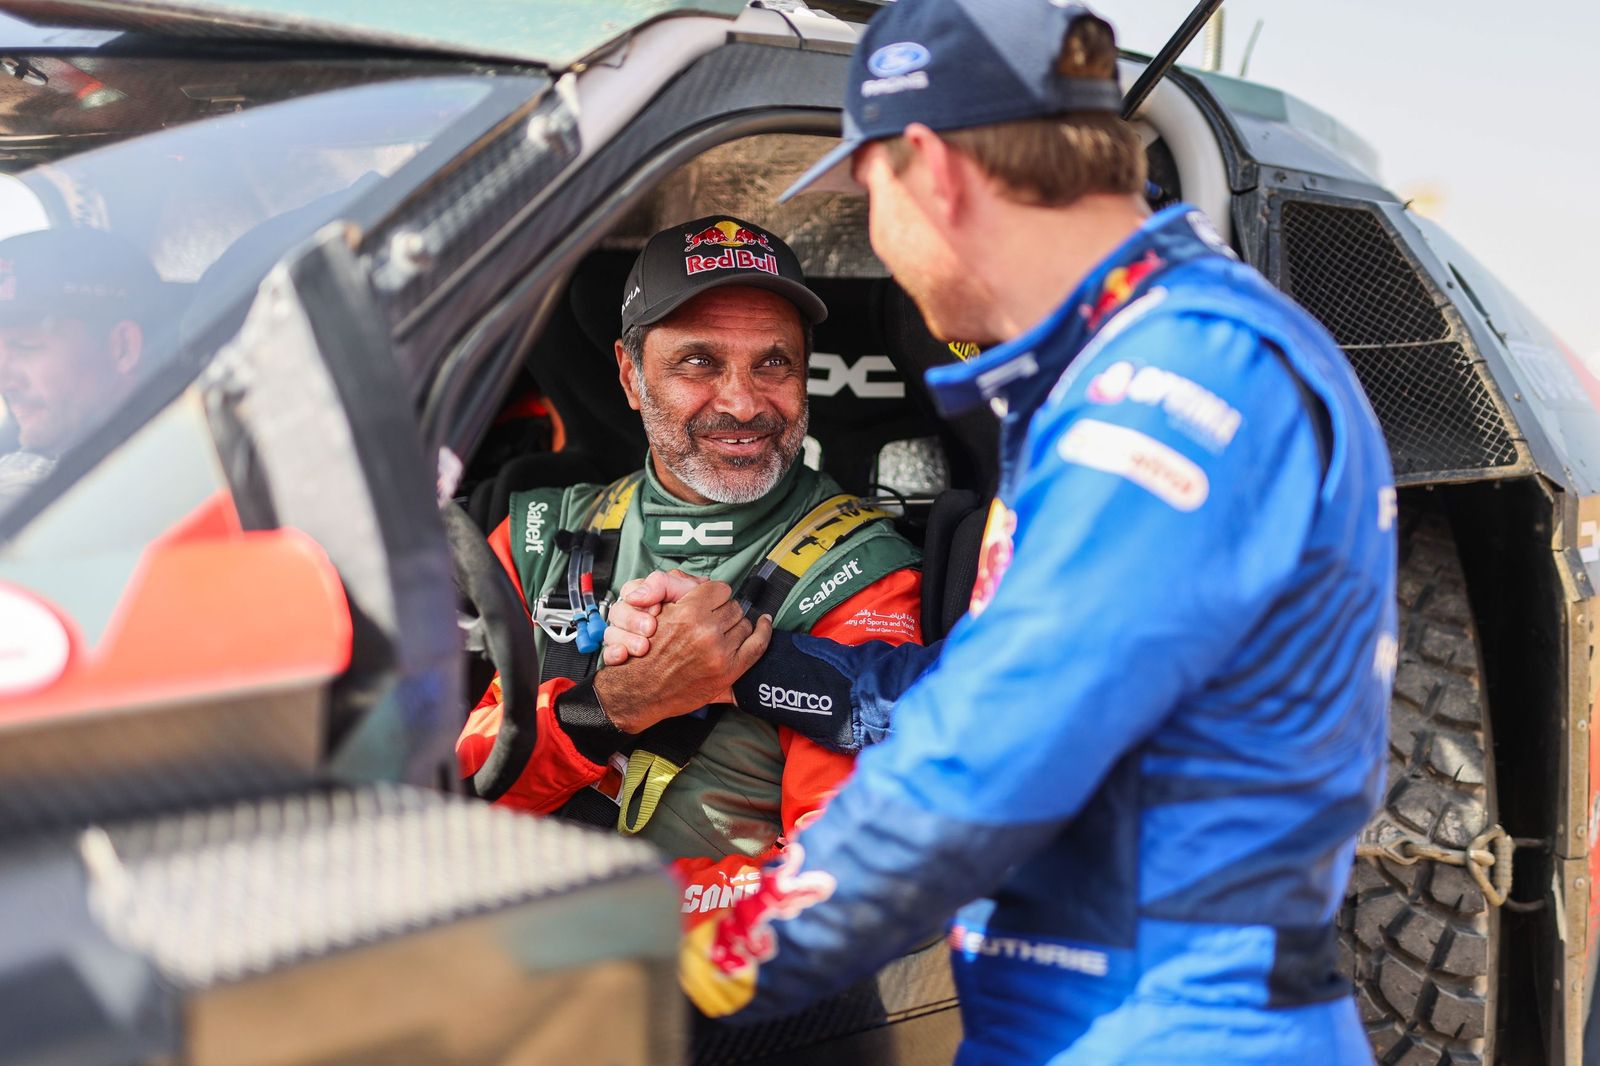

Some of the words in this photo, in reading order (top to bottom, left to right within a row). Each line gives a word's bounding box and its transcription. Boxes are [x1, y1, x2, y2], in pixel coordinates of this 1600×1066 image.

[685, 248, 735, 276] Red
[735, 249, 779, 276] Bull
[525, 501, 549, 556] Sabelt
[798, 558, 863, 615] Sabelt
[858, 617, 867, 625] of
[867, 618, 889, 627] Sports
[758, 683, 833, 716] sparco
